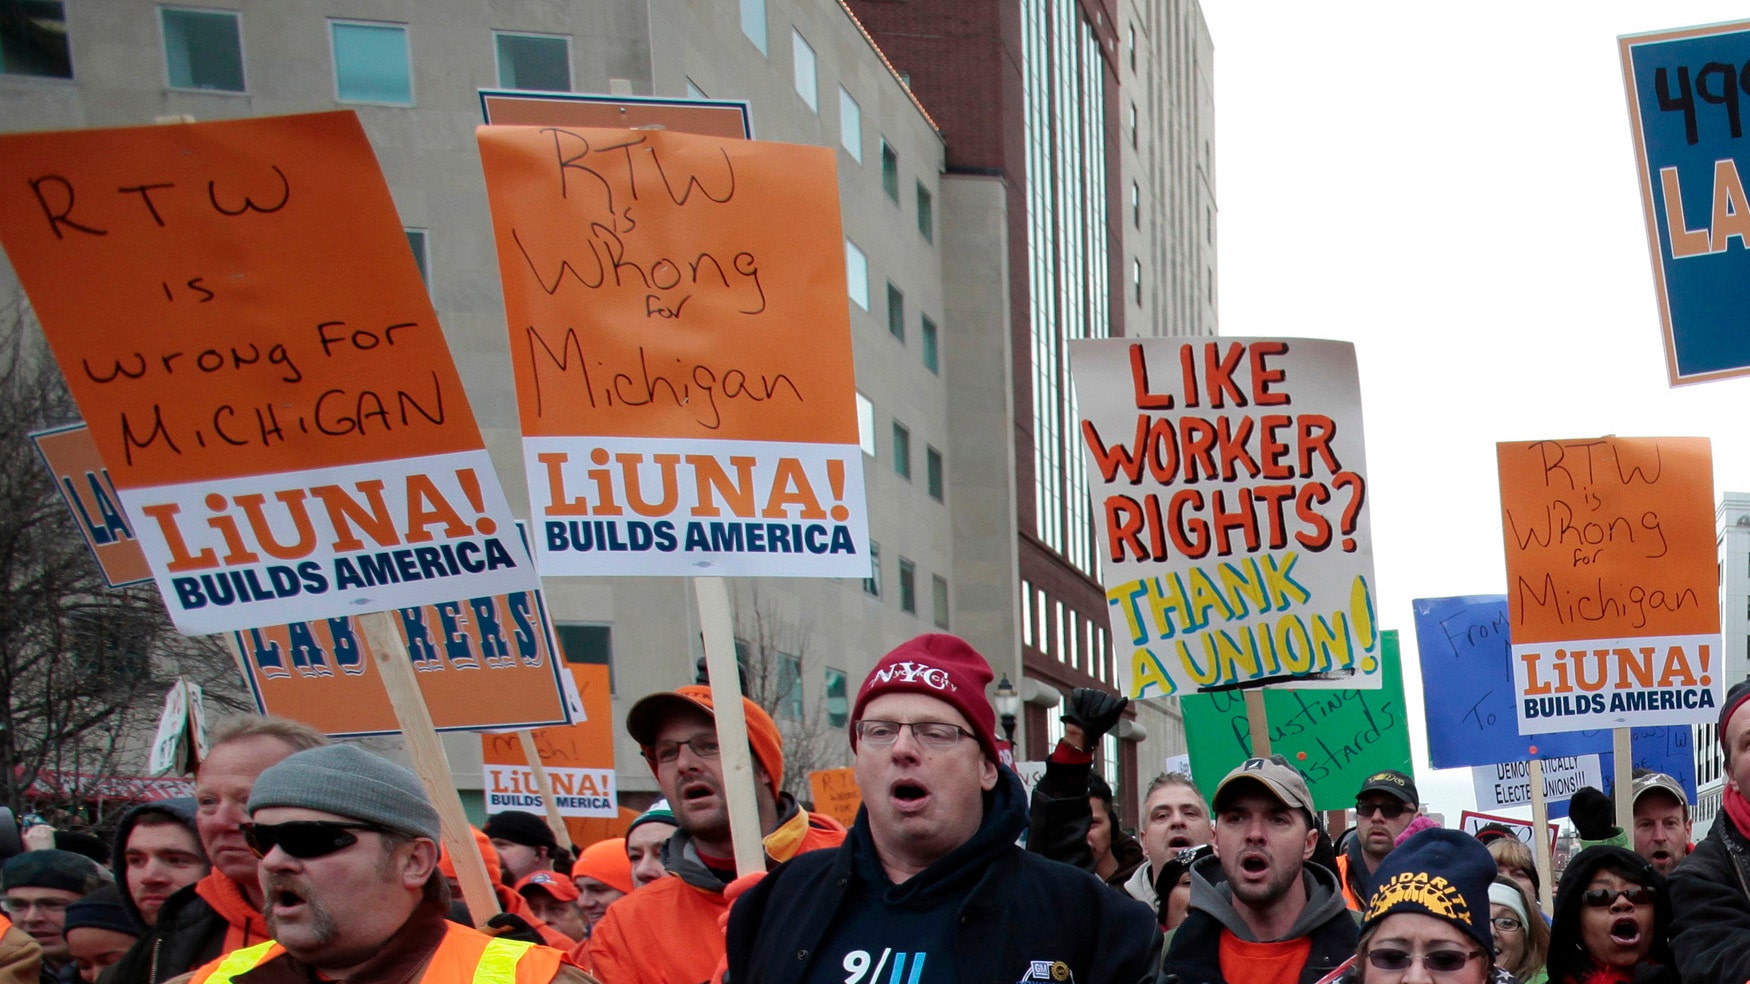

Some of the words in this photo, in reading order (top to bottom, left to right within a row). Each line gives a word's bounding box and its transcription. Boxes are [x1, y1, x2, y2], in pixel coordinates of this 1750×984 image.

[540, 128, 735, 215] RTW
[527, 326, 803, 429] Michigan
[1129, 341, 1291, 410] LIKE
[538, 447, 850, 521] LiUNA!
[1081, 414, 1343, 486] WORKER
[1528, 441, 1661, 490] RTW
[142, 468, 499, 573] LiUNA!
[546, 520, 682, 553] BUILDS
[686, 521, 857, 555] AMERICA
[1103, 471, 1366, 562] RIGHTS?
[172, 559, 329, 610] BUILDS
[335, 537, 517, 591] AMERICA
[1106, 552, 1311, 645] THANK
[1518, 572, 1698, 628] Michigan
[250, 590, 543, 679] LABRERS
[1129, 647, 1176, 698] A
[1176, 575, 1379, 688] UNION!
[872, 661, 948, 690] NYC
[1521, 644, 1712, 695] LiUNA!
[1524, 692, 1606, 718] BUILDS
[1609, 688, 1715, 713] AMERICA
[491, 794, 543, 807] BUILDS
[556, 798, 612, 809] MERICA
[1495, 781, 1532, 804] ELECTE
[1363, 872, 1473, 926] SOLIDARITY
[1034, 963, 1047, 973] GM
